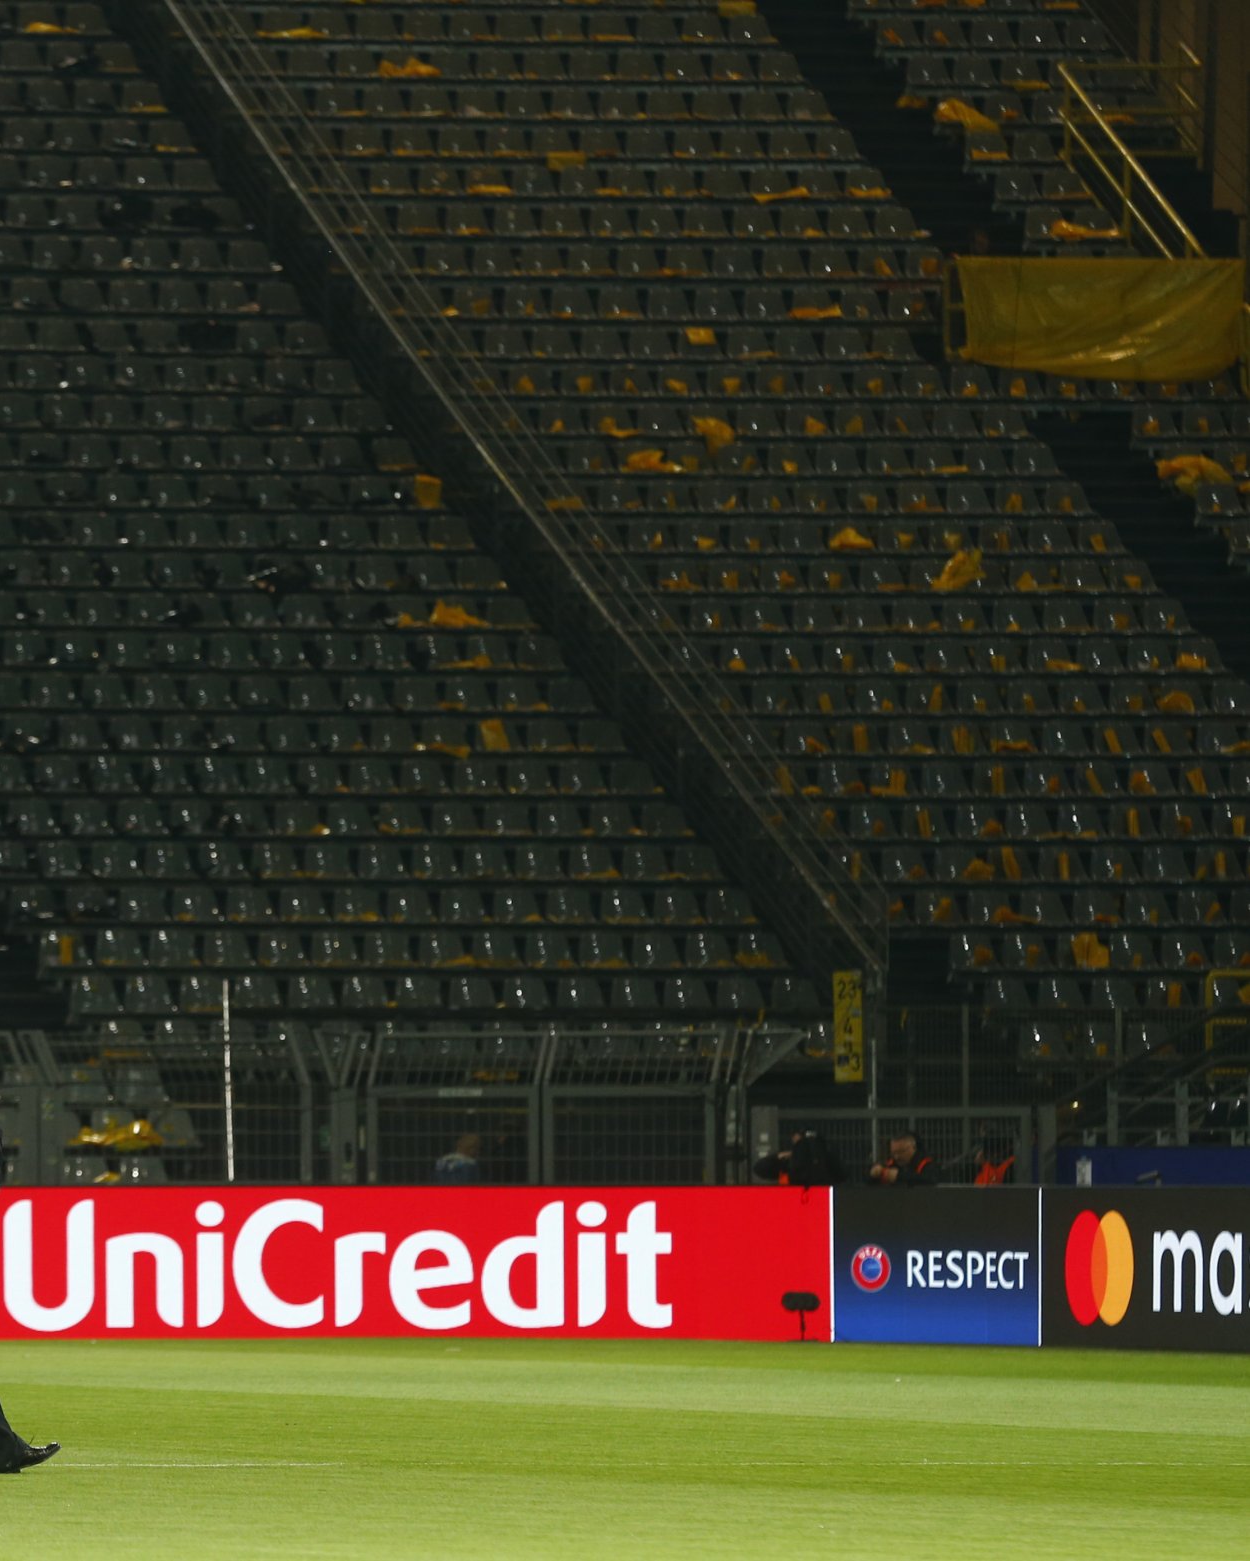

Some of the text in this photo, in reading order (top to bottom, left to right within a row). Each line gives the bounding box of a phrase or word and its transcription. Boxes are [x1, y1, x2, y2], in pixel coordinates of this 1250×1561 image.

[3, 1199, 672, 1331] UniCredit
[858, 1247, 883, 1260] UEFA
[907, 1251, 1028, 1289] RESPECT
[1153, 1231, 1250, 1315] ma
